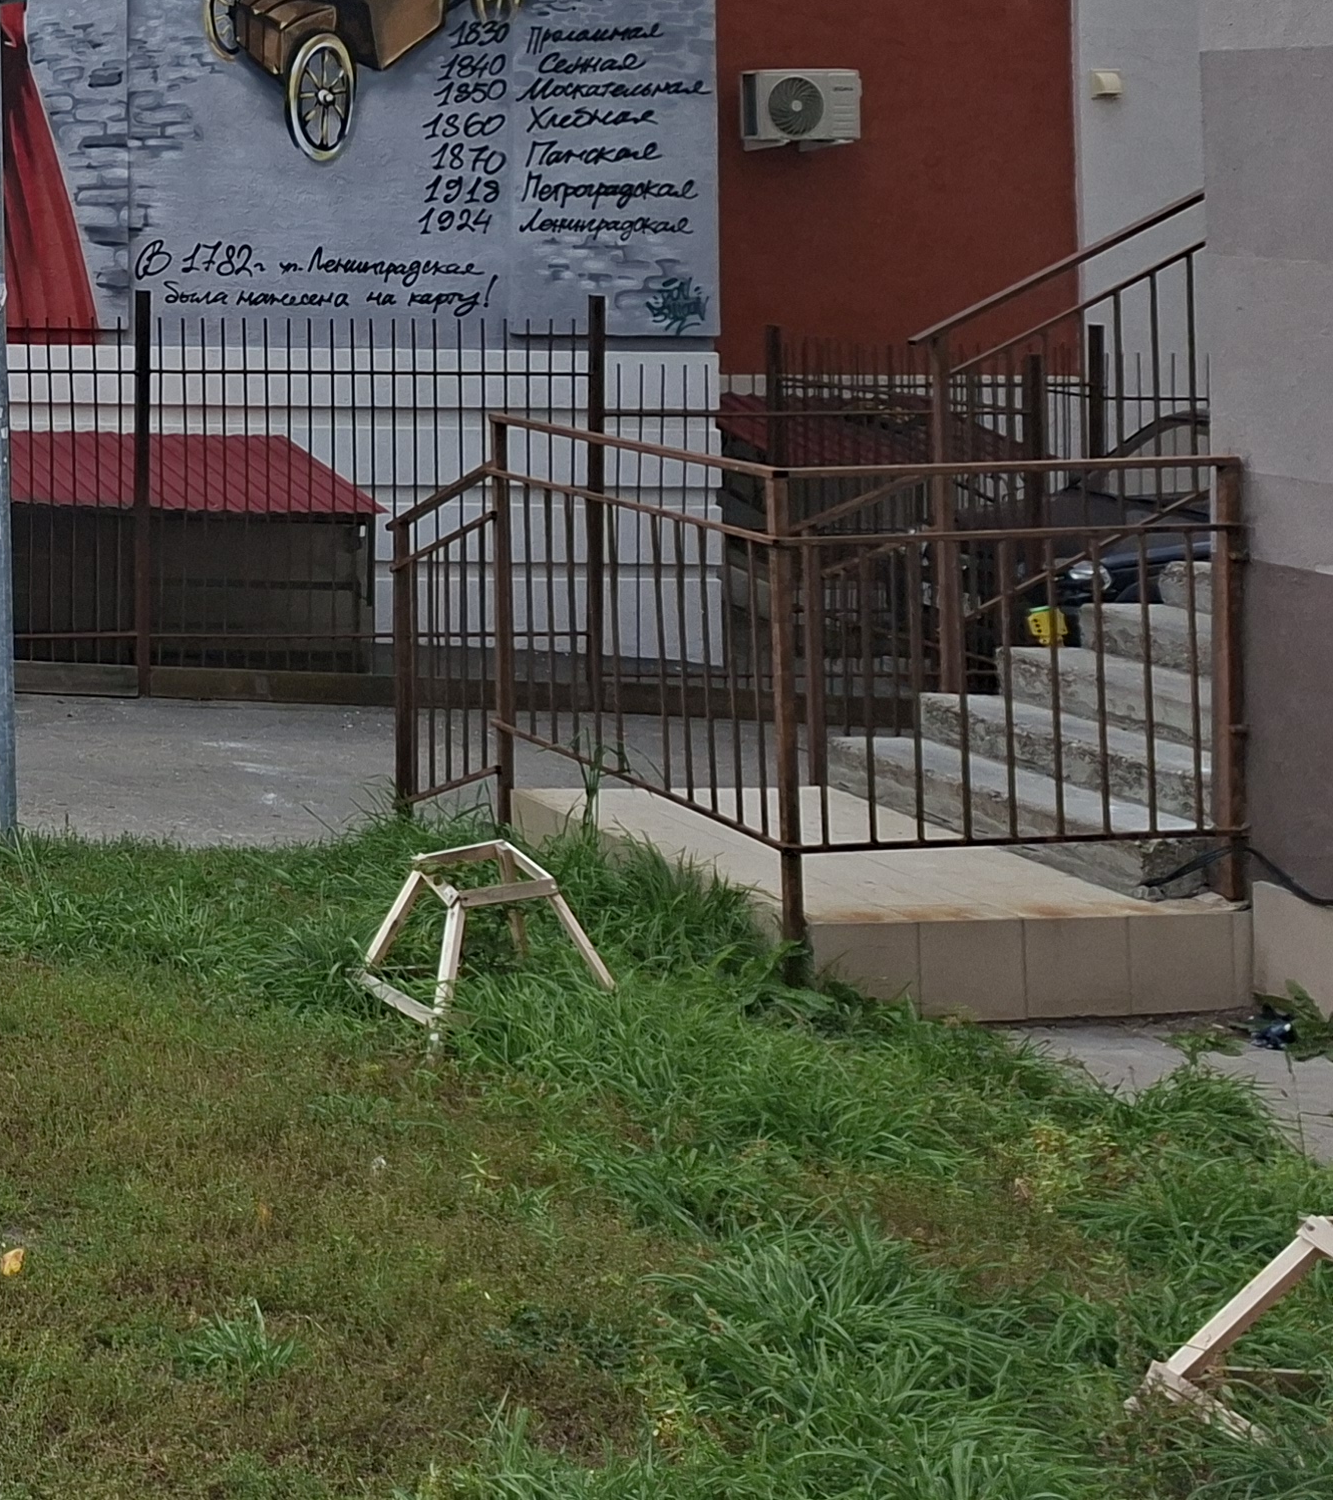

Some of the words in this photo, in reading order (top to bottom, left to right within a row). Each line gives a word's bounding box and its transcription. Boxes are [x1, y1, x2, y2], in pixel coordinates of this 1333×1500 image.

[448, 19, 511, 50] 1830
[436, 52, 507, 82] 1840
[537, 51, 647, 75] Сенная
[433, 78, 508, 108] 1850
[422, 110, 506, 140] 1860
[430, 141, 507, 176] 1870
[525, 140, 663, 168] Панская
[423, 174, 501, 204] 1918
[417, 207, 493, 235] 1924
[365, 291, 397, 306] на
